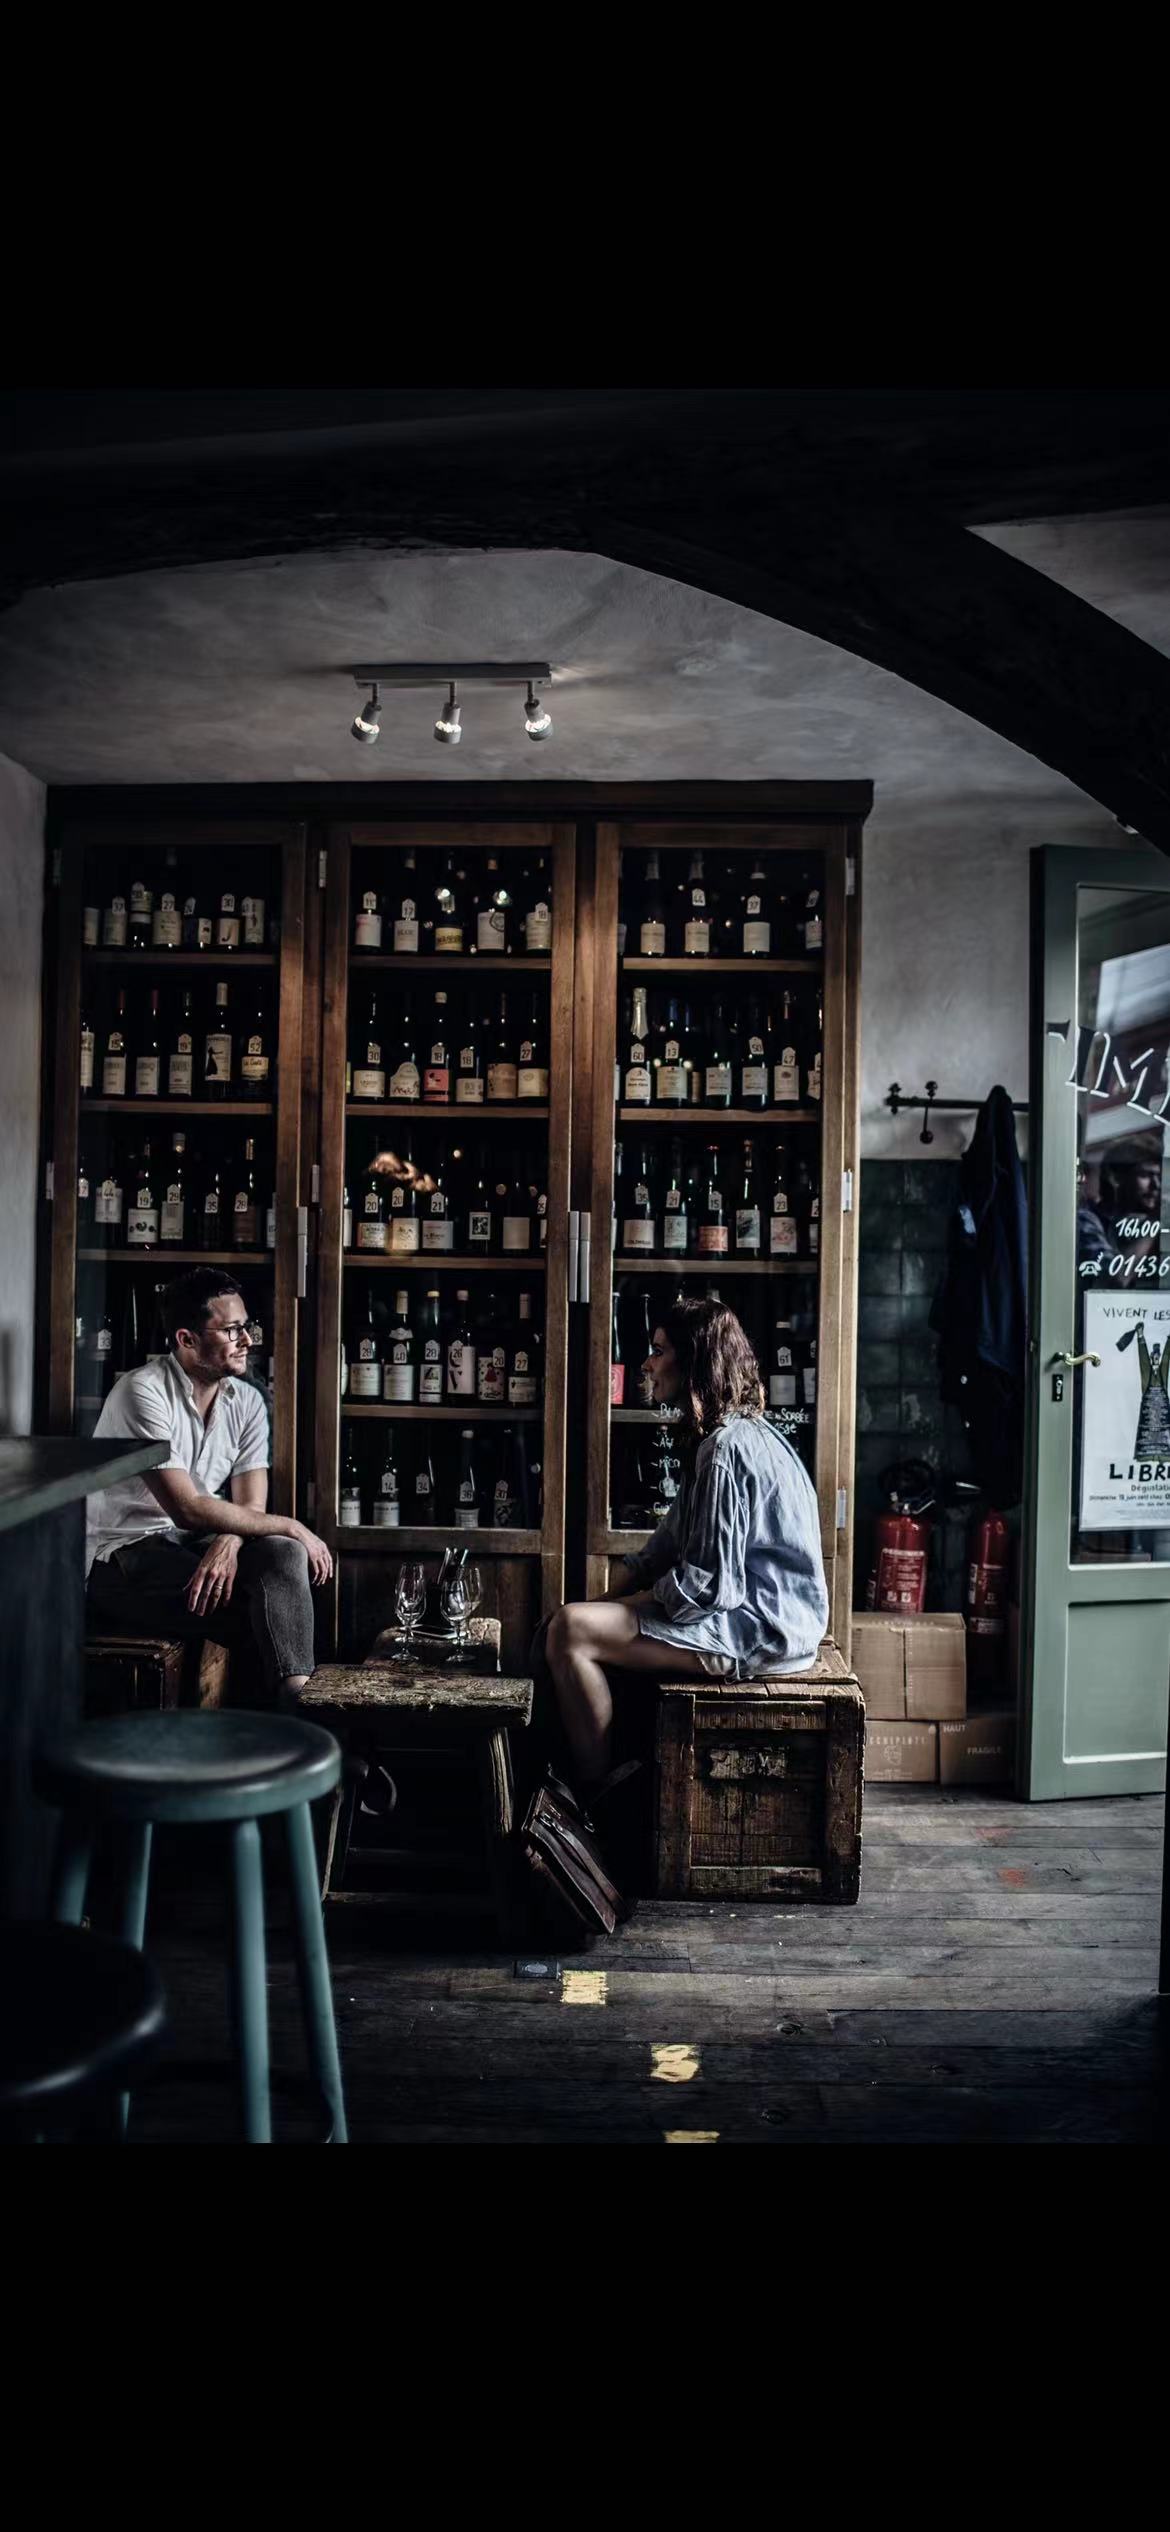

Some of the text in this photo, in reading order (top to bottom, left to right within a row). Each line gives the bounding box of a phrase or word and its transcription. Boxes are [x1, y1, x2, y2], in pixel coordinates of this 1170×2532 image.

[1103, 1306, 1149, 1318] VIVENT
[1131, 1484, 1170, 1493] Dégustati
[943, 1724, 966, 1733] HAUT
